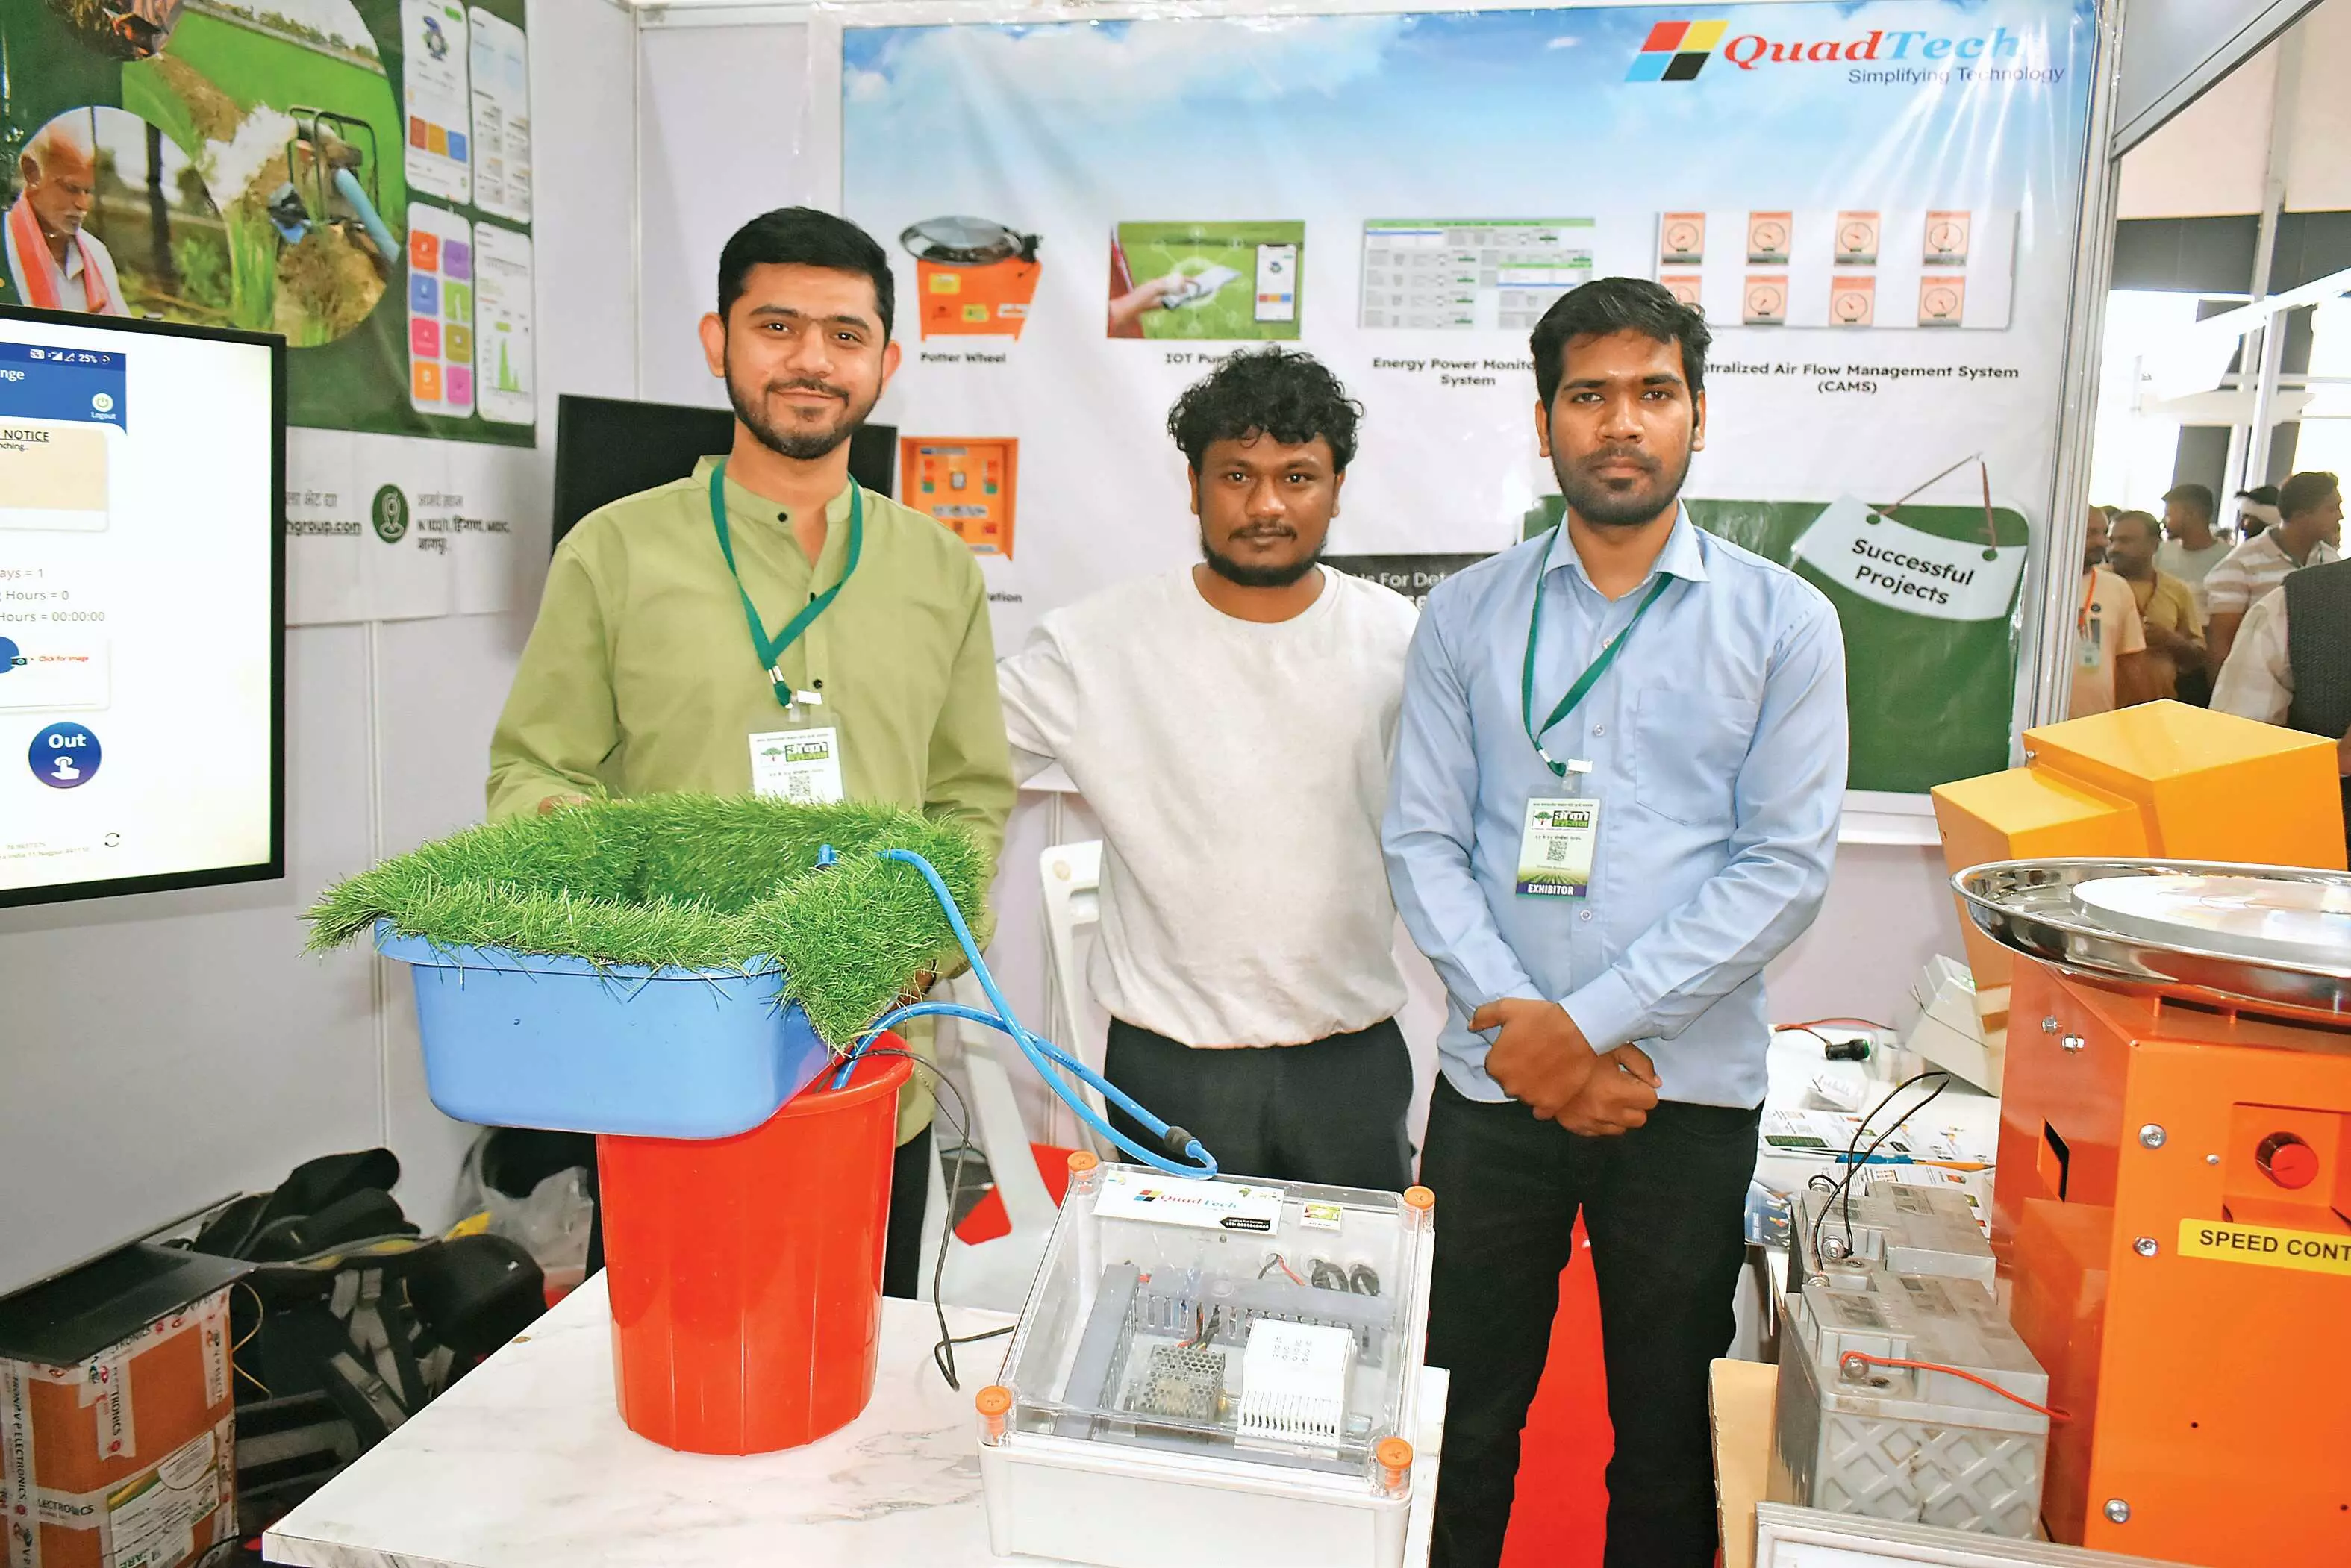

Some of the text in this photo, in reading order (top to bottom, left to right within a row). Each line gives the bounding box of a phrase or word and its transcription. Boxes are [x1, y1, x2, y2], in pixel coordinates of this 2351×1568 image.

[1724, 27, 2020, 70] QuadTech
[1848, 66, 2065, 84] Simplifying Technology
[920, 351, 1006, 363] Potter Wheel
[1166, 353, 1192, 363] IOT
[1373, 357, 1425, 375] Energy
[1431, 358, 1477, 371] Power
[1775, 363, 1802, 375] Air
[1804, 363, 1840, 375] Flow
[1847, 365, 1952, 379] Management
[1958, 366, 2020, 379] System
[1441, 375, 1496, 389] System
[1817, 381, 1877, 394] (CAMS)
[91, 411, 116, 420] Logout
[4, 429, 49, 443] NOTICE
[1852, 537, 1975, 586] Successful
[1380, 572, 1410, 588] For
[1855, 565, 1949, 605] Projects
[6, 590, 46, 600] Hours
[51, 611, 105, 622] 00:00:00
[48, 733, 87, 749] Out
[1528, 884, 1574, 896] EXHIBITOR
[2199, 1229, 2351, 1261] SPEED CONT
[14, 1431, 26, 1500] ELECTRONICS
